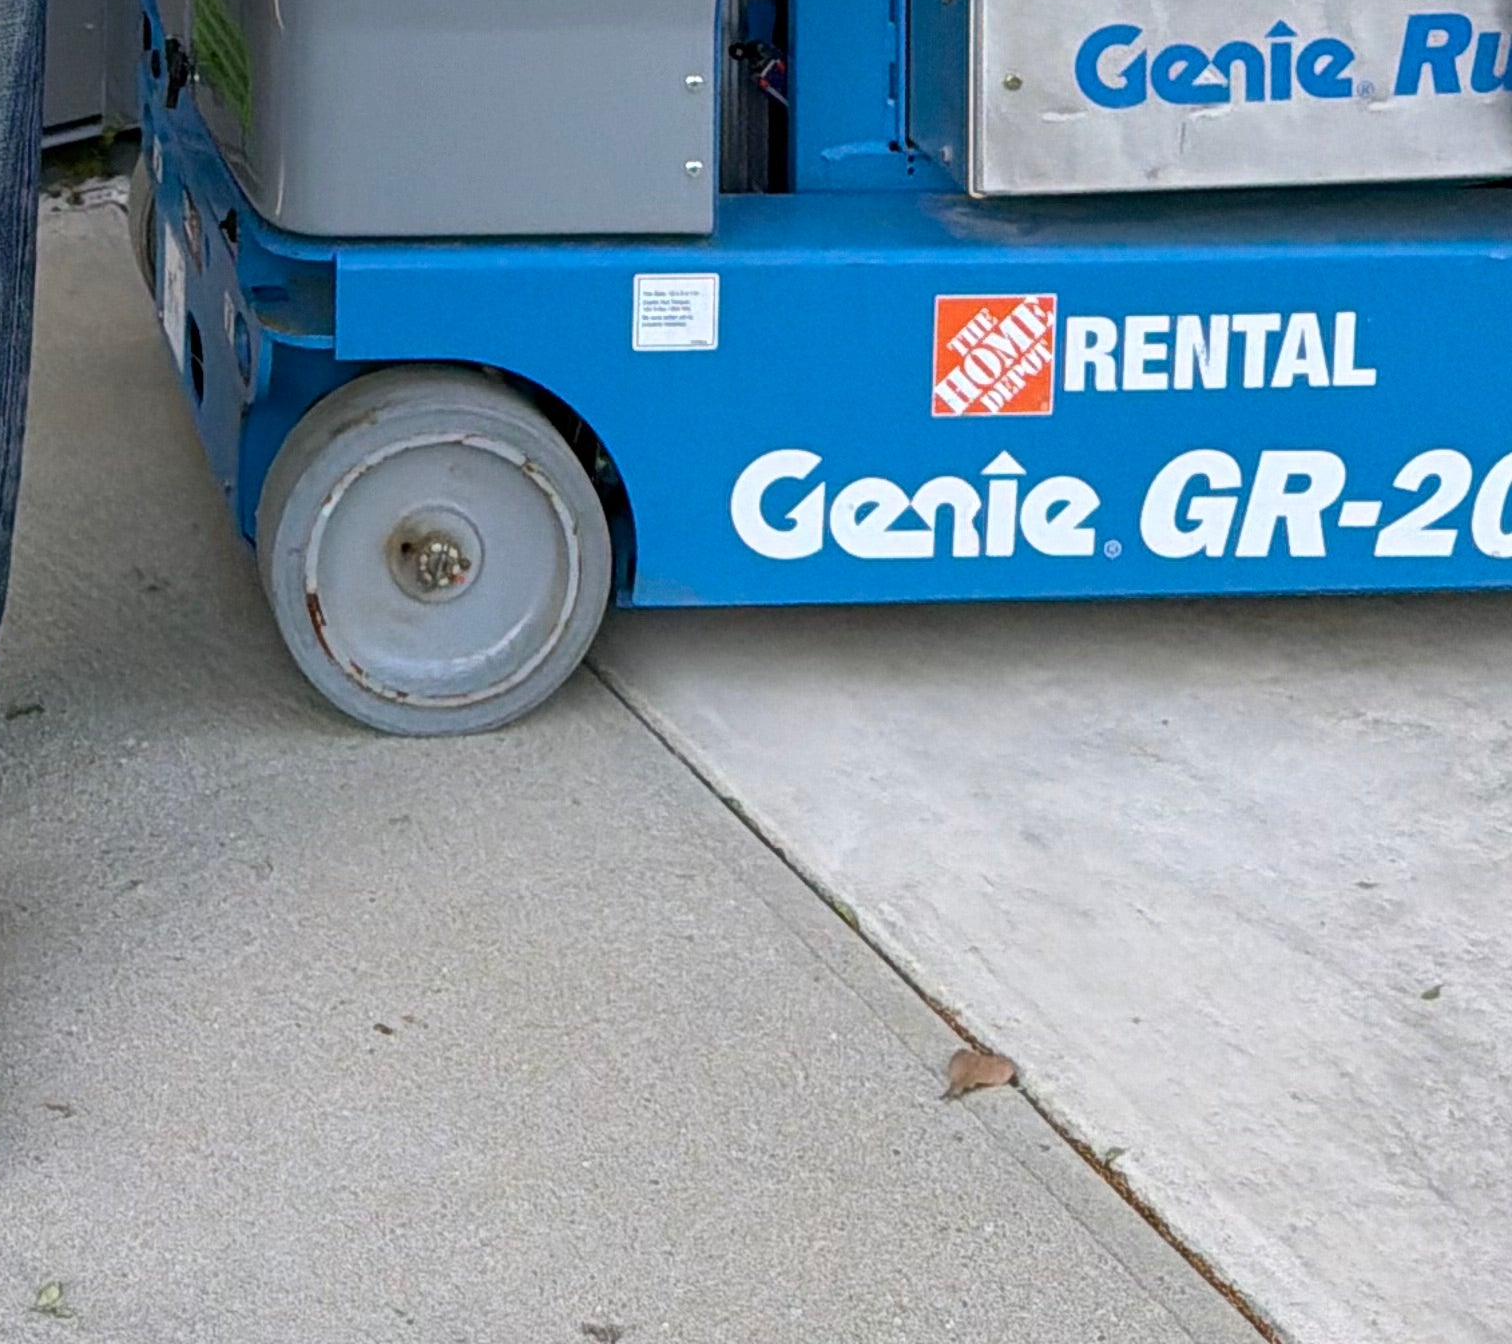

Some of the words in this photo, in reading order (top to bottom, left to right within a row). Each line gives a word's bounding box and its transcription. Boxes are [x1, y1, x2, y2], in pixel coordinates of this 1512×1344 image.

[1074, 19, 1355, 110] Genie
[934, 296, 1054, 414] HOME
[946, 307, 999, 357] THE
[1064, 312, 1377, 392] RENTAL
[979, 338, 1053, 413] DEPOT
[731, 448, 1101, 560] Genie
